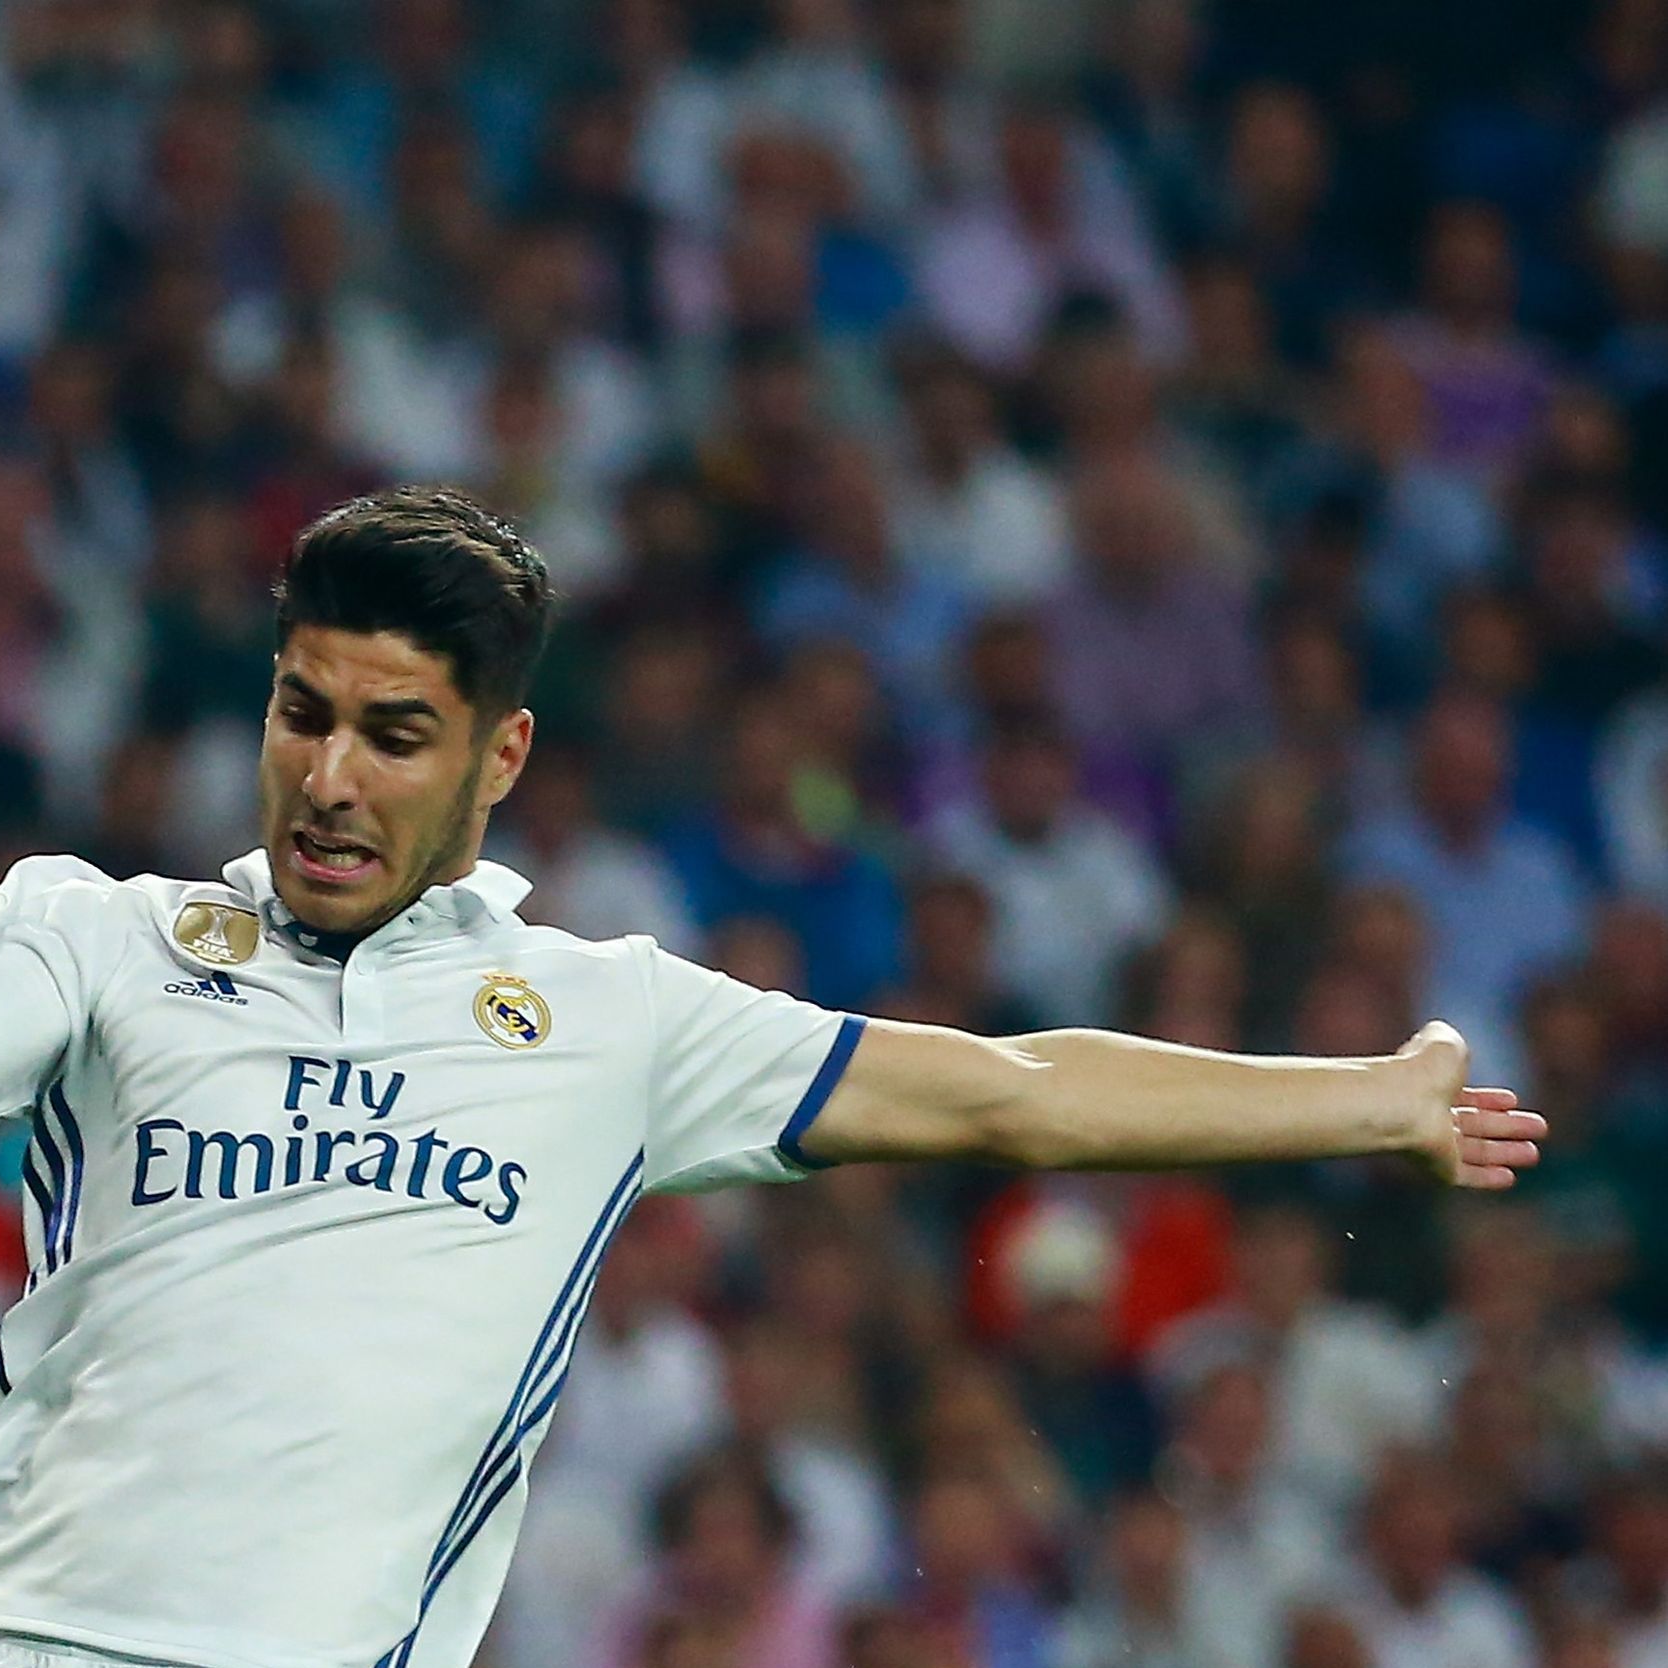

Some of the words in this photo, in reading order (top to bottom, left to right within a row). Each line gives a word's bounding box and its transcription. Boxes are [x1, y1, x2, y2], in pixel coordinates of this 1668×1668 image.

[164, 981, 248, 1006] adidas
[284, 1055, 405, 1120] Fly
[131, 1113, 527, 1225] Emirates
